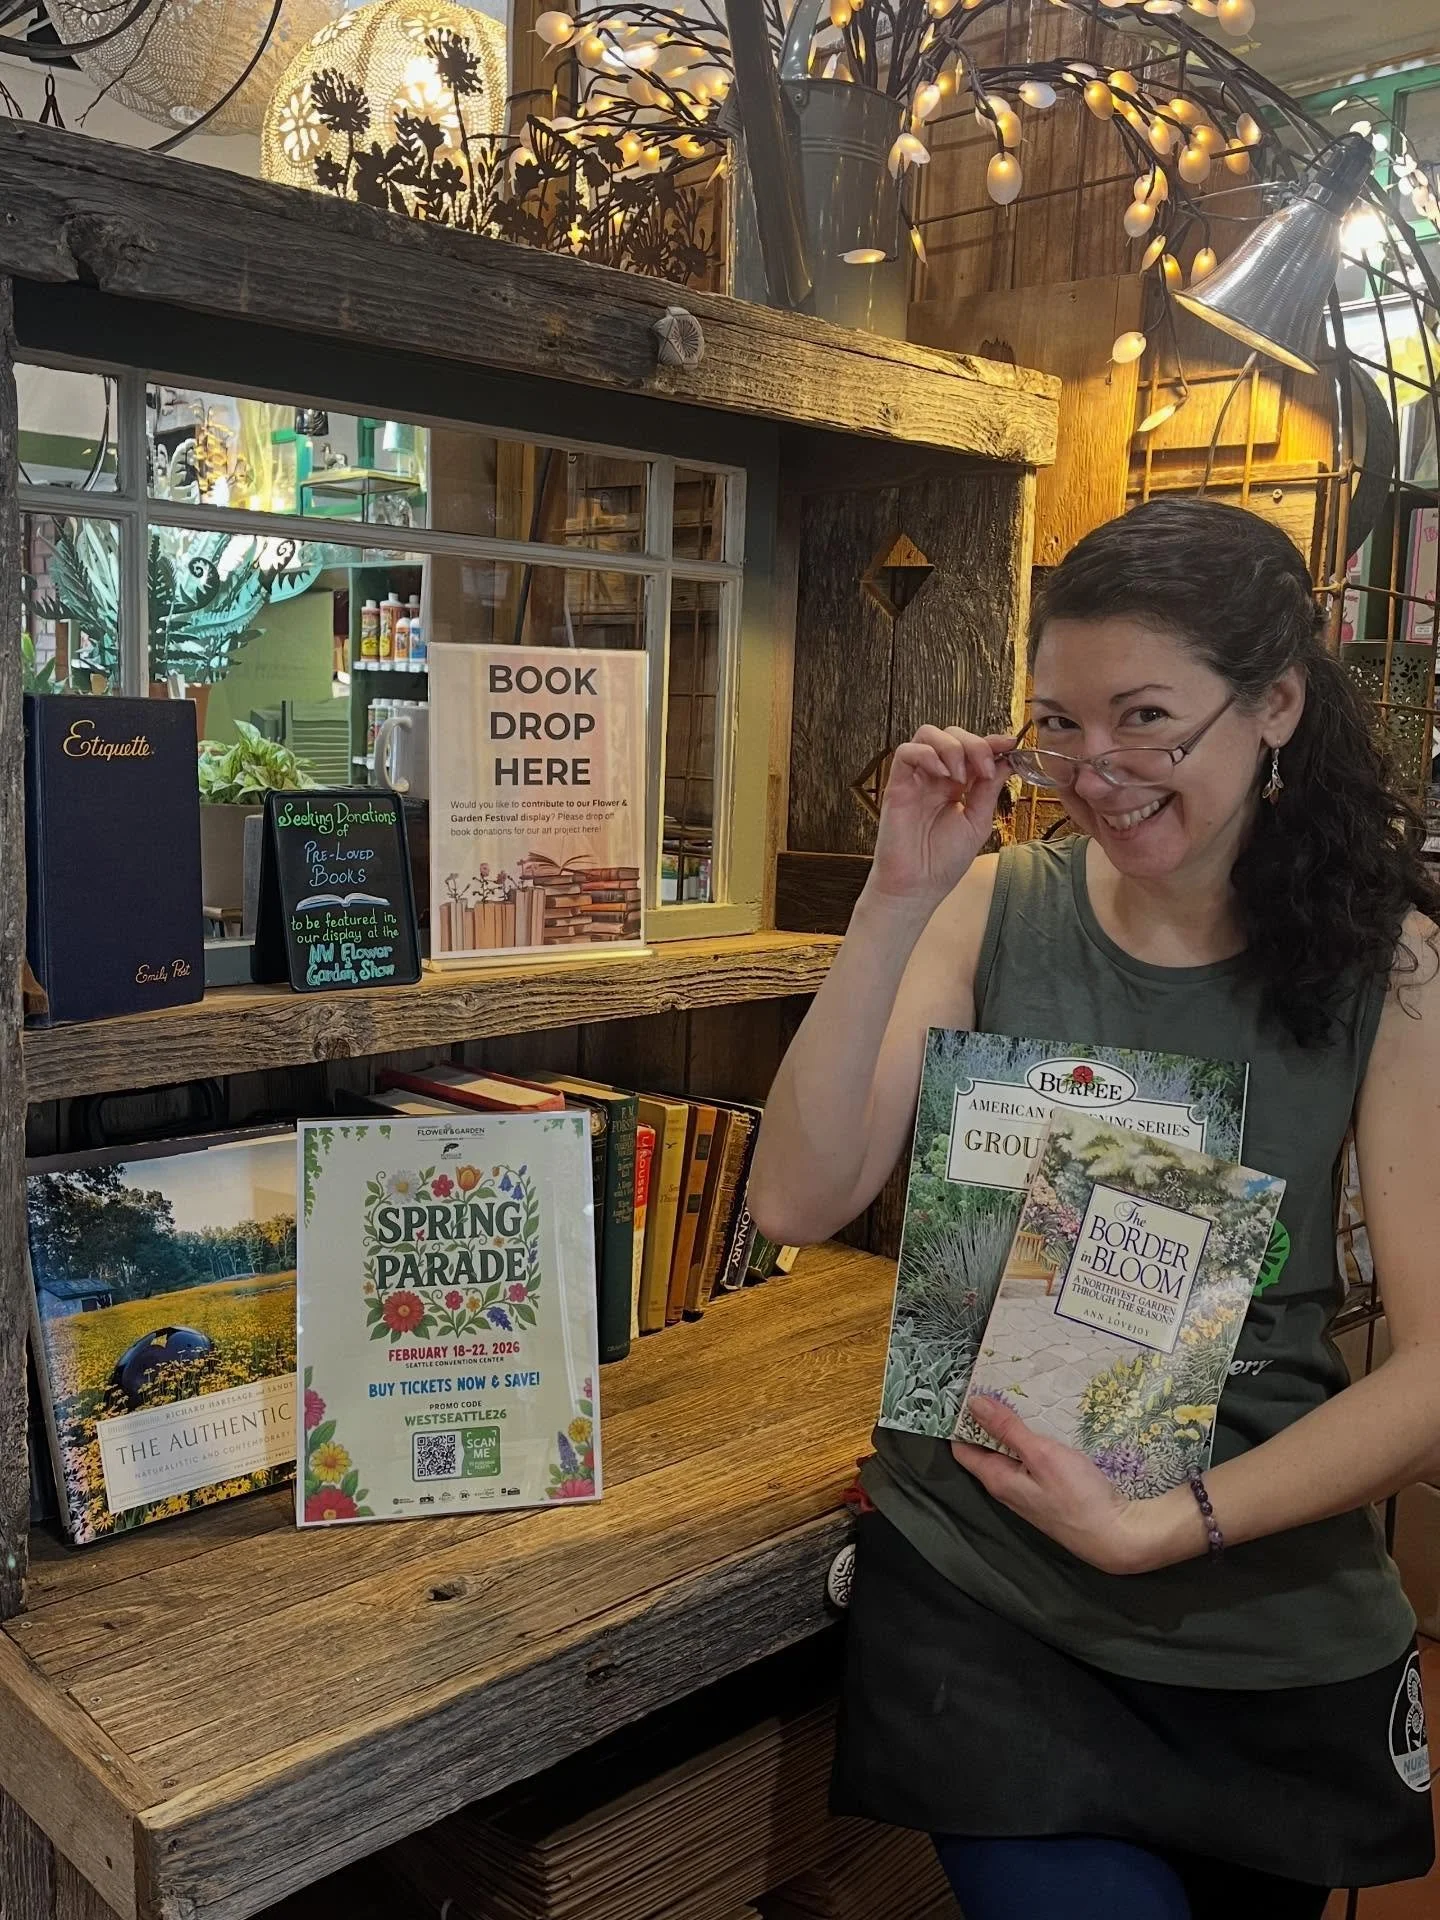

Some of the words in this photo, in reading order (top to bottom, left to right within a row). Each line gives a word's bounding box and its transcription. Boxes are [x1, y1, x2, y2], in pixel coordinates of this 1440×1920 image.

[489, 664, 598, 696] BOOK
[490, 711, 596, 741] DROP
[495, 757, 591, 786] HERE
[278, 801, 335, 835] Seeking
[334, 801, 397, 826] Donations
[450, 800, 477, 809] Would
[478, 802, 494, 810] you
[496, 800, 510, 808] like
[521, 799, 565, 808] contribute
[566, 800, 575, 808] to
[592, 799, 620, 808] Flower
[621, 799, 628, 807] &
[450, 814, 483, 823] Garden
[485, 813, 519, 823] Festival
[520, 813, 556, 823] display?
[557, 812, 584, 821] Please
[585, 812, 604, 822] drop
[337, 823, 349, 837] of
[450, 827, 471, 836] book
[472, 826, 513, 836] donations
[514, 826, 525, 834] for
[541, 826, 552, 834] art
[554, 825, 581, 836] project
[291, 916, 303, 931] to
[306, 914, 321, 930] be
[325, 907, 378, 927] featured
[384, 911, 398, 924] in
[297, 933, 320, 944] our
[322, 928, 362, 945] display
[367, 926, 379, 938] at
[383, 925, 400, 938] the
[309, 942, 335, 964] NW
[135, 964, 168, 984] Emily
[171, 959, 191, 978] Post
[359, 958, 396, 981] Show
[968, 1098, 1045, 1120] AMERICAN
[1136, 1118, 1191, 1138] SERIES
[417, 1128, 448, 1137] FLOWER
[449, 1128, 455, 1136] &
[454, 1127, 485, 1136] GARDEN
[964, 1127, 1044, 1160] GROU
[378, 1201, 522, 1244] SPRING
[1113, 1200, 1147, 1228] The
[1088, 1214, 1190, 1272] BORDER
[376, 1248, 527, 1290] PARADE
[1080, 1250, 1092, 1265] in
[1091, 1246, 1186, 1299] BLOOM
[1072, 1283, 1117, 1306] THROUGH
[1117, 1299, 1135, 1312] THE
[1136, 1306, 1175, 1325] SEASONS
[1074, 1274, 1081, 1284] A
[1082, 1277, 1138, 1303] NORTHWEST
[1138, 1297, 1177, 1316] GARDEN
[1083, 1308, 1104, 1321] ANN
[1108, 1317, 1150, 1338] LOVEJOY
[388, 1345, 449, 1362] FEBRUARY
[492, 1341, 520, 1355] 2026
[435, 1358, 478, 1367] CONVENTION
[479, 1356, 505, 1364] CENTER
[368, 1382, 396, 1398] BUY
[400, 1379, 452, 1395] TICKETS
[457, 1376, 486, 1392] NOW
[491, 1375, 500, 1389] &
[504, 1371, 541, 1388] SAVE!
[165, 1402, 206, 1420] RICHARD
[267, 1381, 295, 1394] SANDY
[429, 1401, 460, 1411] PROMO
[461, 1400, 483, 1409] CODE
[404, 1408, 508, 1427] WESTSEATTLE26
[116, 1436, 162, 1466] THE
[170, 1402, 293, 1452] AUTHENTIC
[466, 1437, 497, 1449] SCAN
[134, 1455, 200, 1480] NATURALISTIC
[202, 1449, 220, 1461] AND
[222, 1430, 292, 1456] CONTEMPORARY
[473, 1448, 491, 1459] ME
